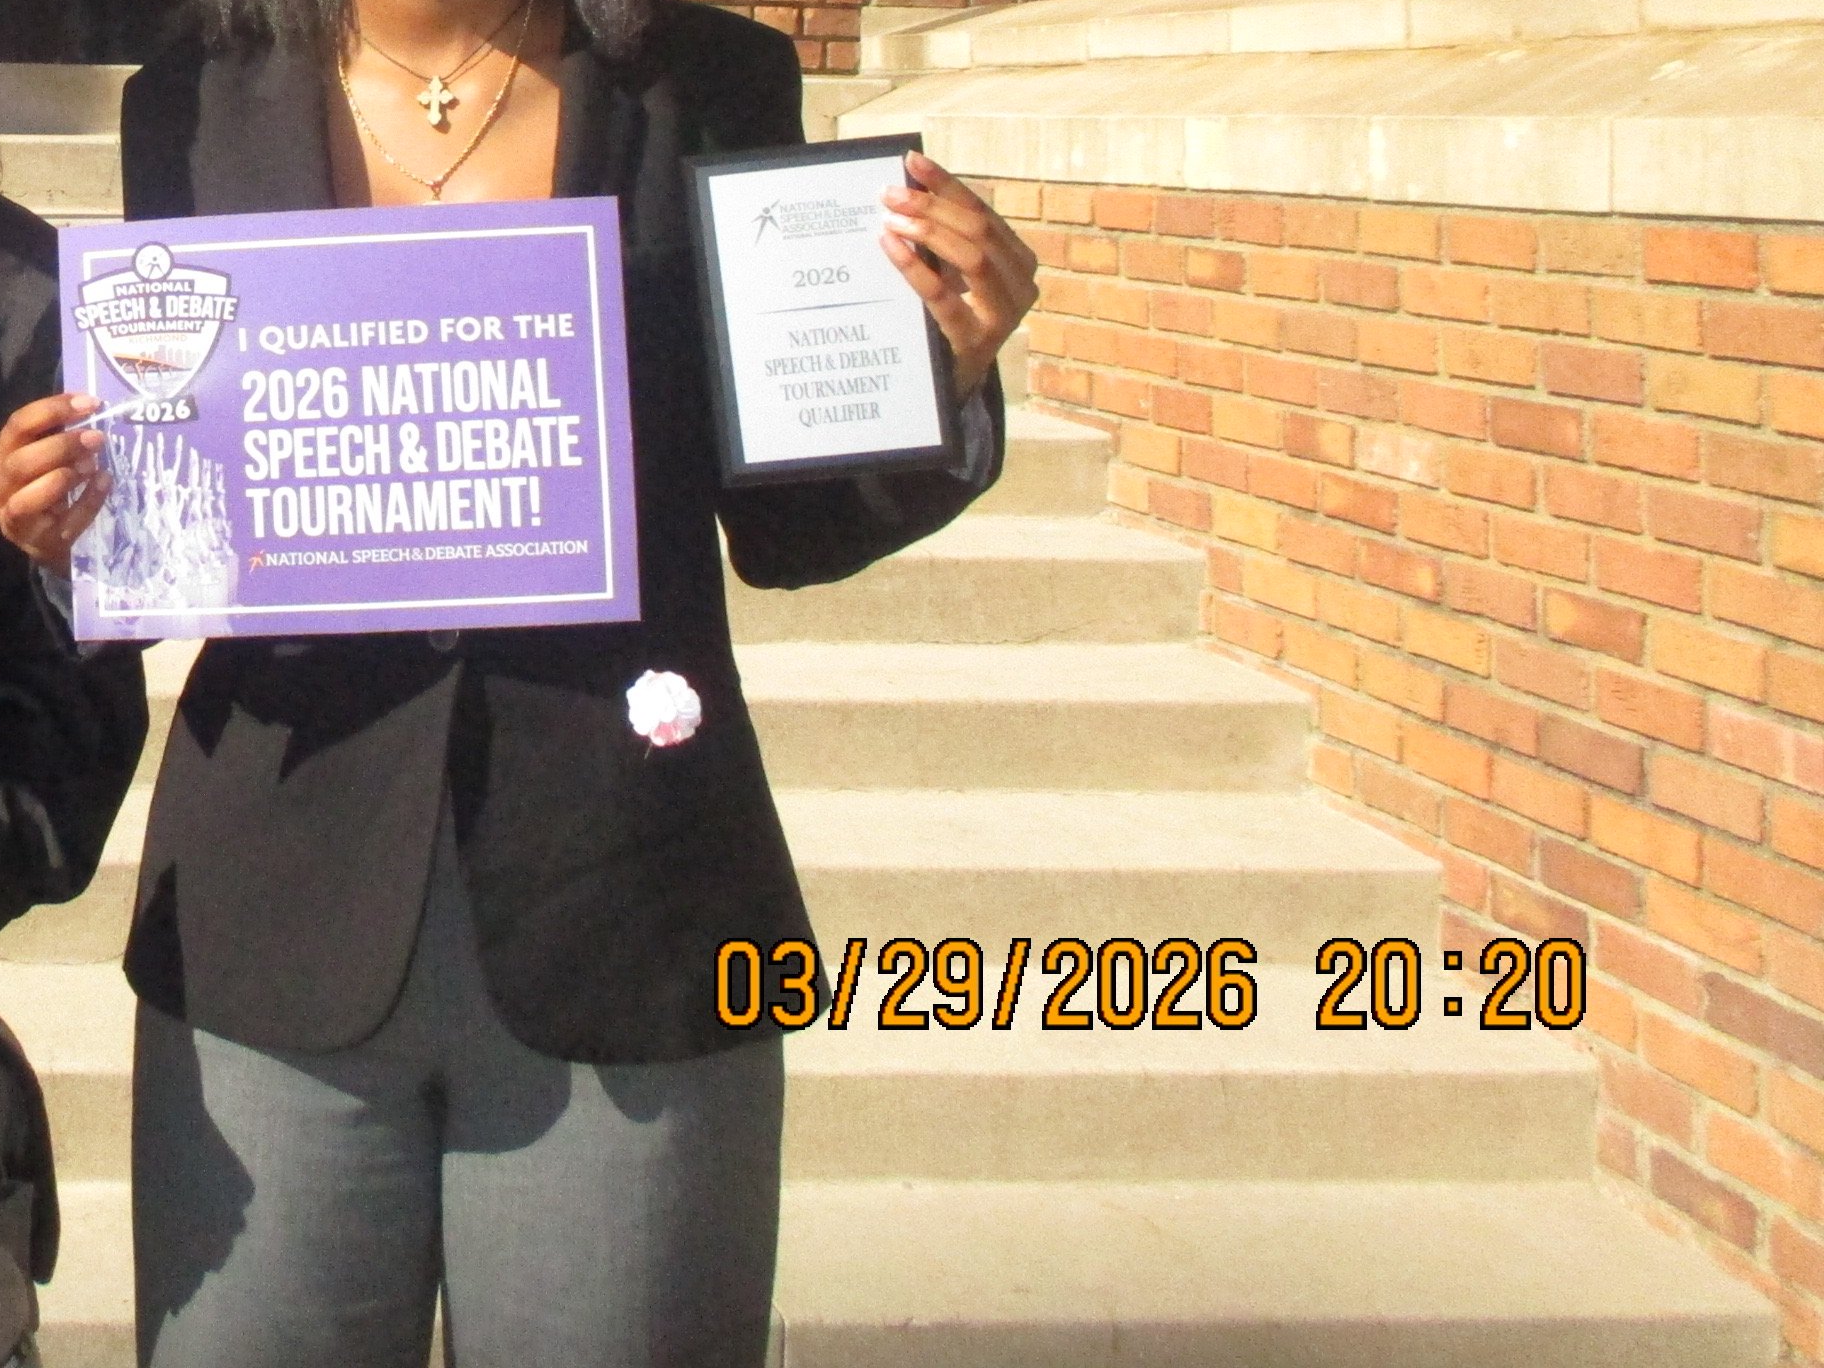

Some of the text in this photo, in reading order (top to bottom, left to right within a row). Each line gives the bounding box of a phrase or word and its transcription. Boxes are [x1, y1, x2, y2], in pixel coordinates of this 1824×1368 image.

[780, 199, 840, 213] NATIONAL
[782, 217, 858, 233] ASSOCIATION
[116, 282, 192, 296] NATIONAL
[793, 265, 850, 287] 2026
[75, 295, 238, 329] SPEECH & DEBATE
[109, 320, 203, 336] TOURNAMENT
[238, 313, 575, 355] I QUALIFIED FOR THE
[788, 324, 870, 348] NATIONAL
[764, 346, 902, 377] SPEECH & DEBATE
[242, 357, 562, 422] 2026 NATIONAL
[779, 374, 890, 401] TOURNAMENT
[129, 400, 191, 422] 2026
[799, 401, 881, 428] QUALIFIER
[244, 415, 582, 481] SPEECH & DEBATE
[245, 476, 541, 538] TOURNAMENT!
[265, 550, 348, 567] NATIONAL
[485, 540, 588, 558] ASSOCIATION
